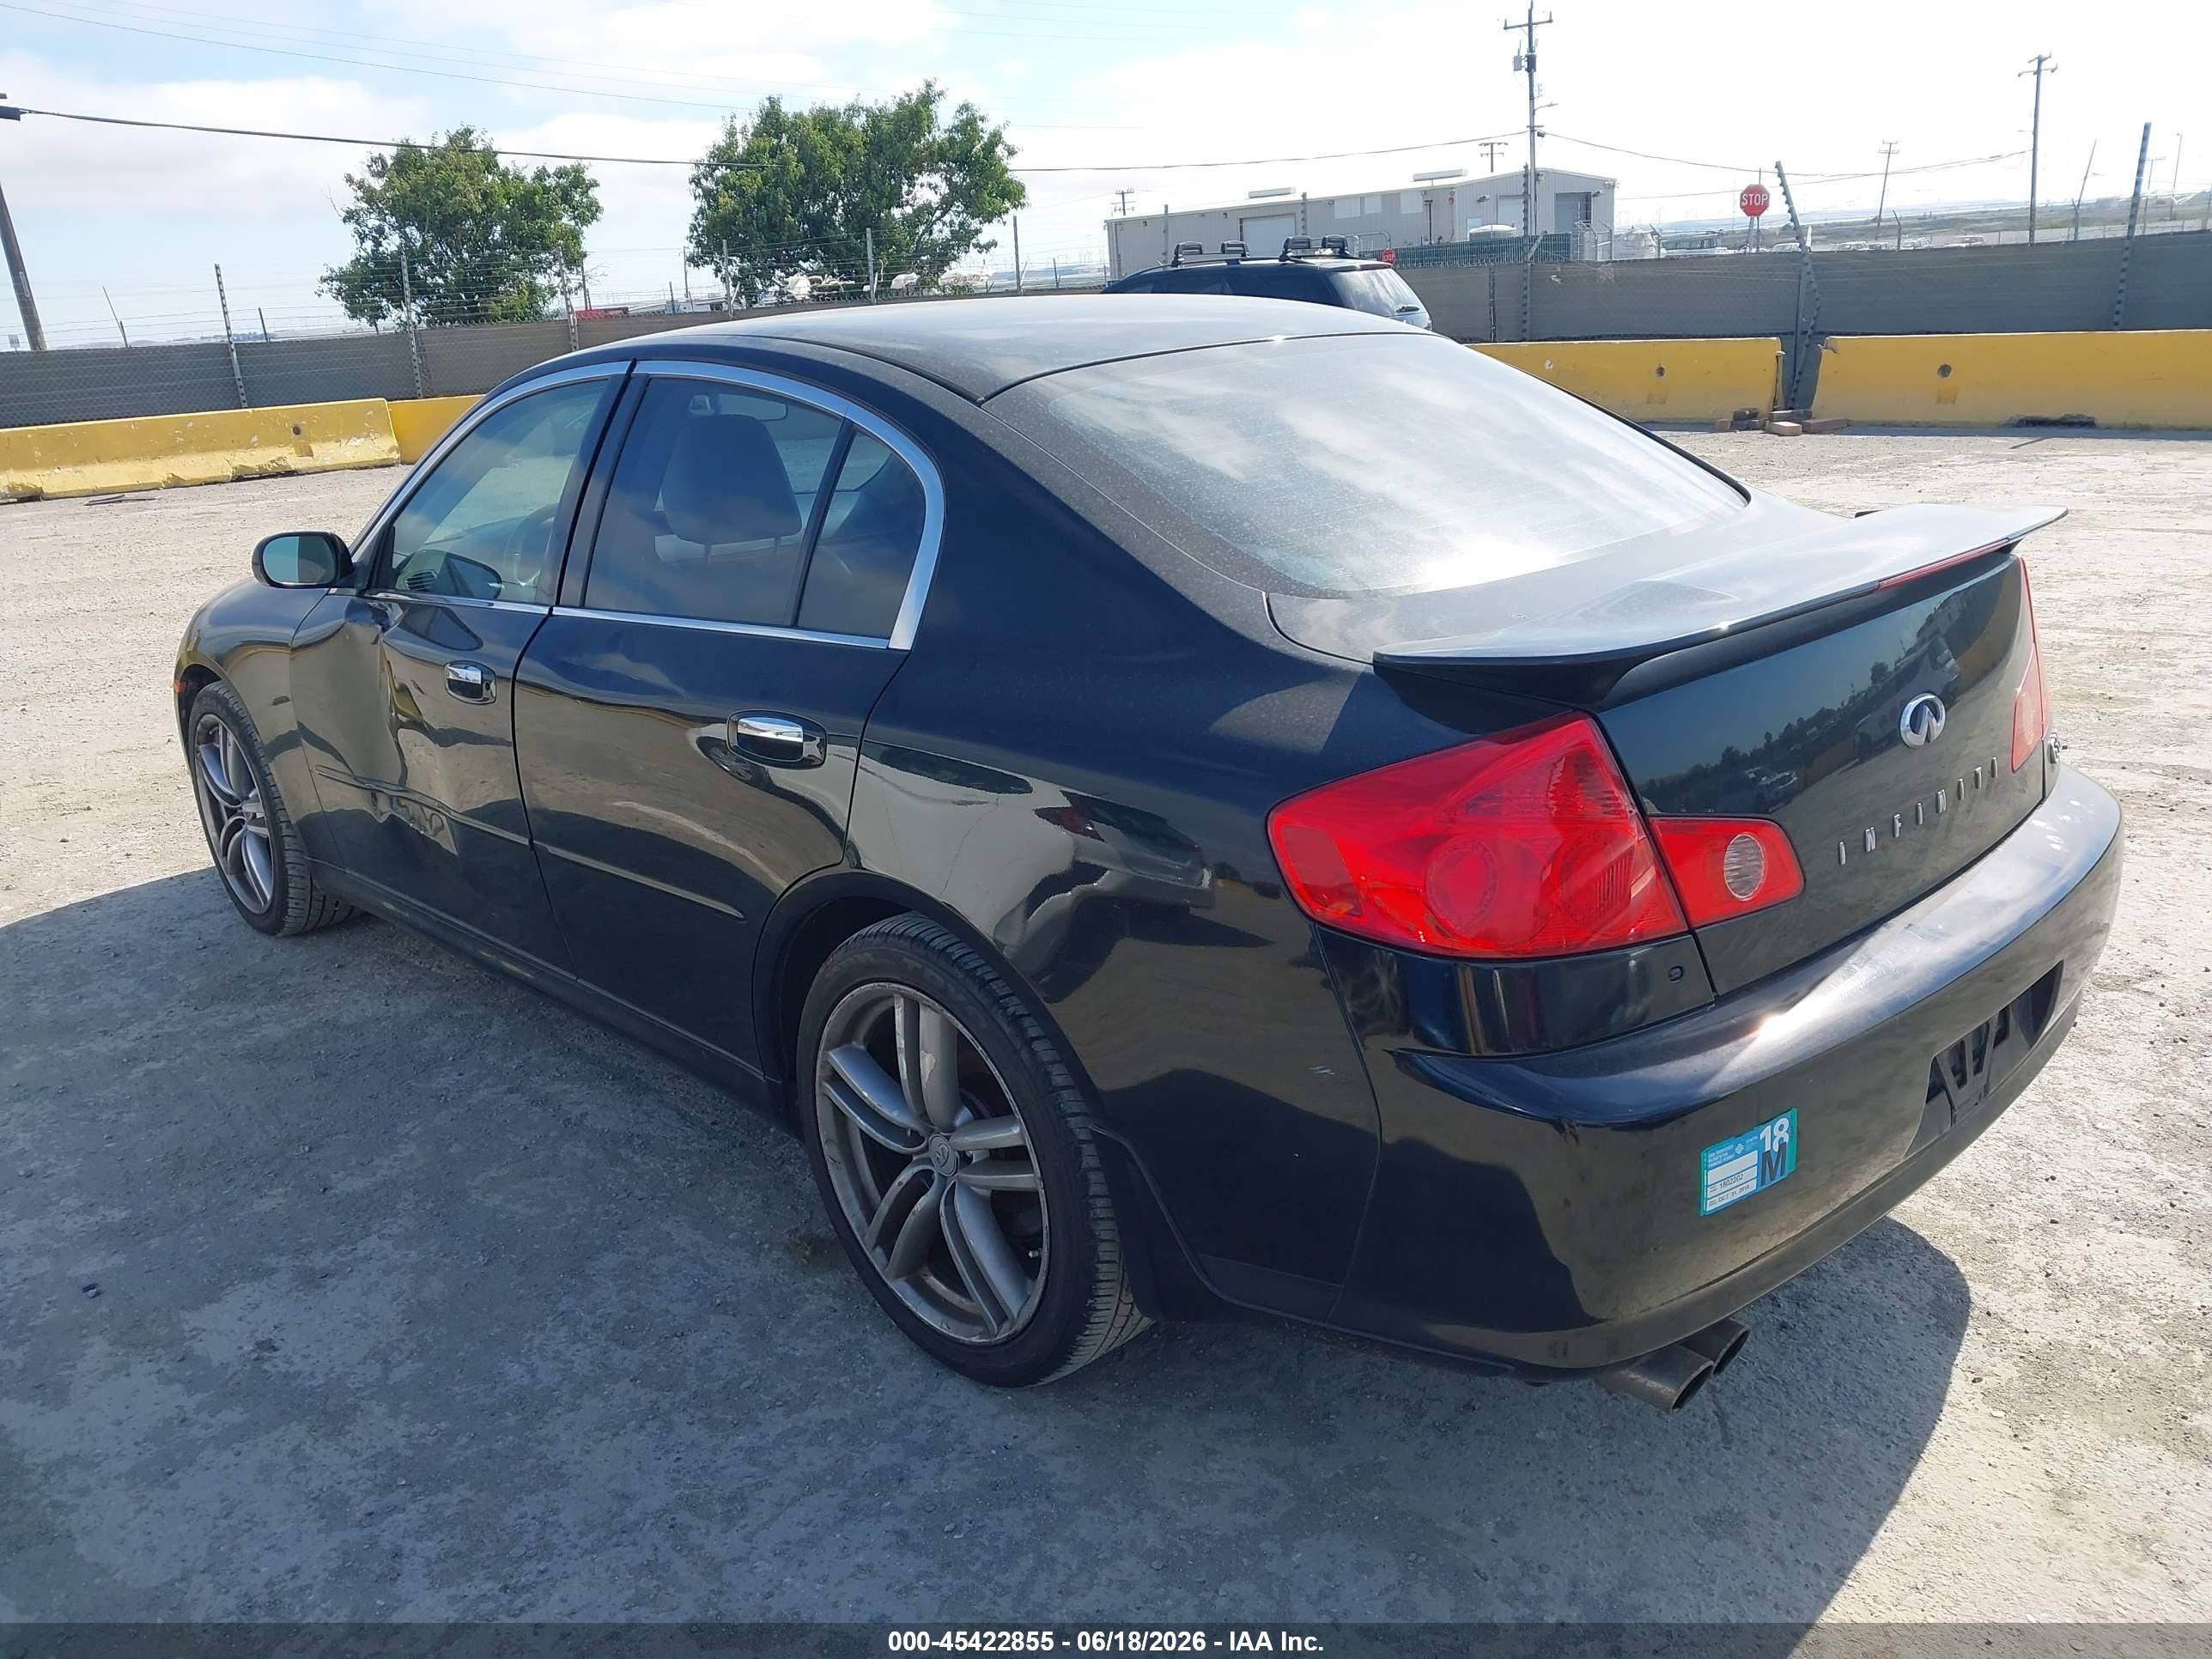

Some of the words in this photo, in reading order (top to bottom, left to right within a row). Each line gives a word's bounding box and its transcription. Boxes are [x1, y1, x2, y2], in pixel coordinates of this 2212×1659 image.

[1742, 193, 1768, 206] STOP
[1838, 756, 1998, 866] INFINITI
[1760, 1118, 1790, 1152] 18
[1761, 1141, 1787, 1187] M
